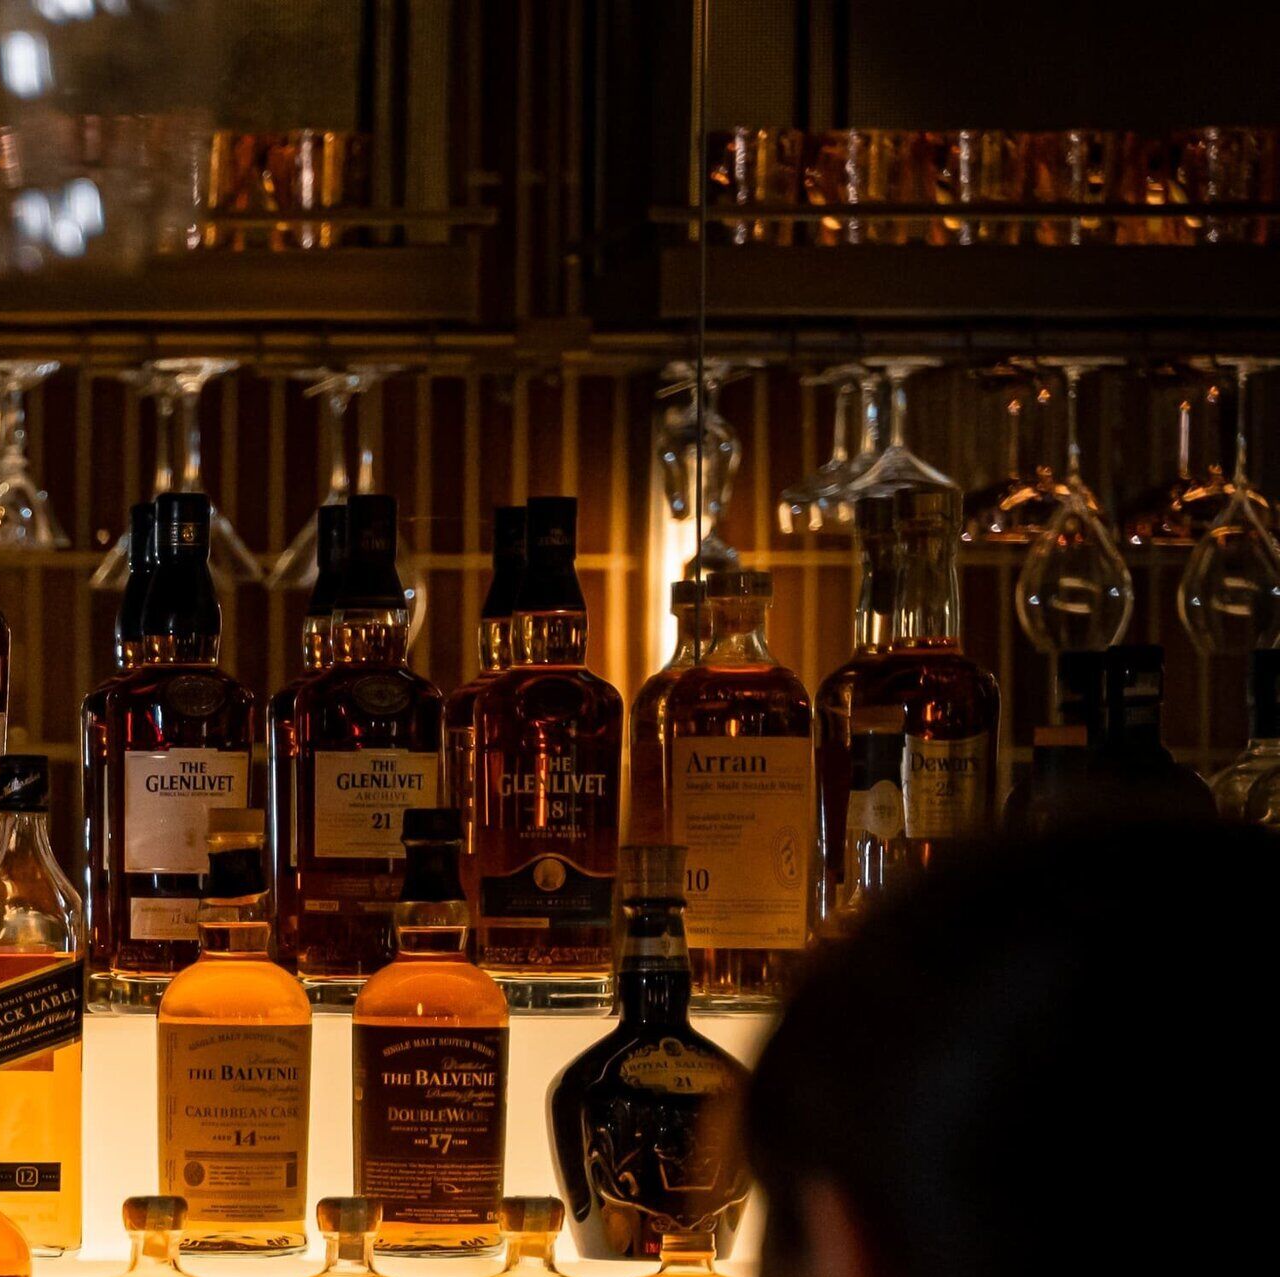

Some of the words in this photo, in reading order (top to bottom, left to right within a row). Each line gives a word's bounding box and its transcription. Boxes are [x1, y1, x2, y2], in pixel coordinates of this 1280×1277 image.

[179, 762, 207, 774] THE
[371, 760, 396, 772] THE
[543, 757, 571, 772] HE
[686, 752, 767, 773] Arran
[146, 775, 234, 792] GLENLIVET
[336, 773, 423, 790] GLENLIVET
[371, 813, 391, 829] 21
[686, 869, 709, 891] 10
[30, 988, 80, 1016] LABEL
[414, 1037, 436, 1048] MALT
[187, 1069, 217, 1080] THE
[221, 1065, 299, 1081] BALVENIE
[381, 1072, 412, 1085] THE
[415, 1069, 495, 1086] BALVENIE
[185, 1106, 267, 1119] CARIBBEAN
[234, 1130, 256, 1147] 14
[429, 1133, 453, 1154] 17
[20, 1171, 34, 1183] 12
